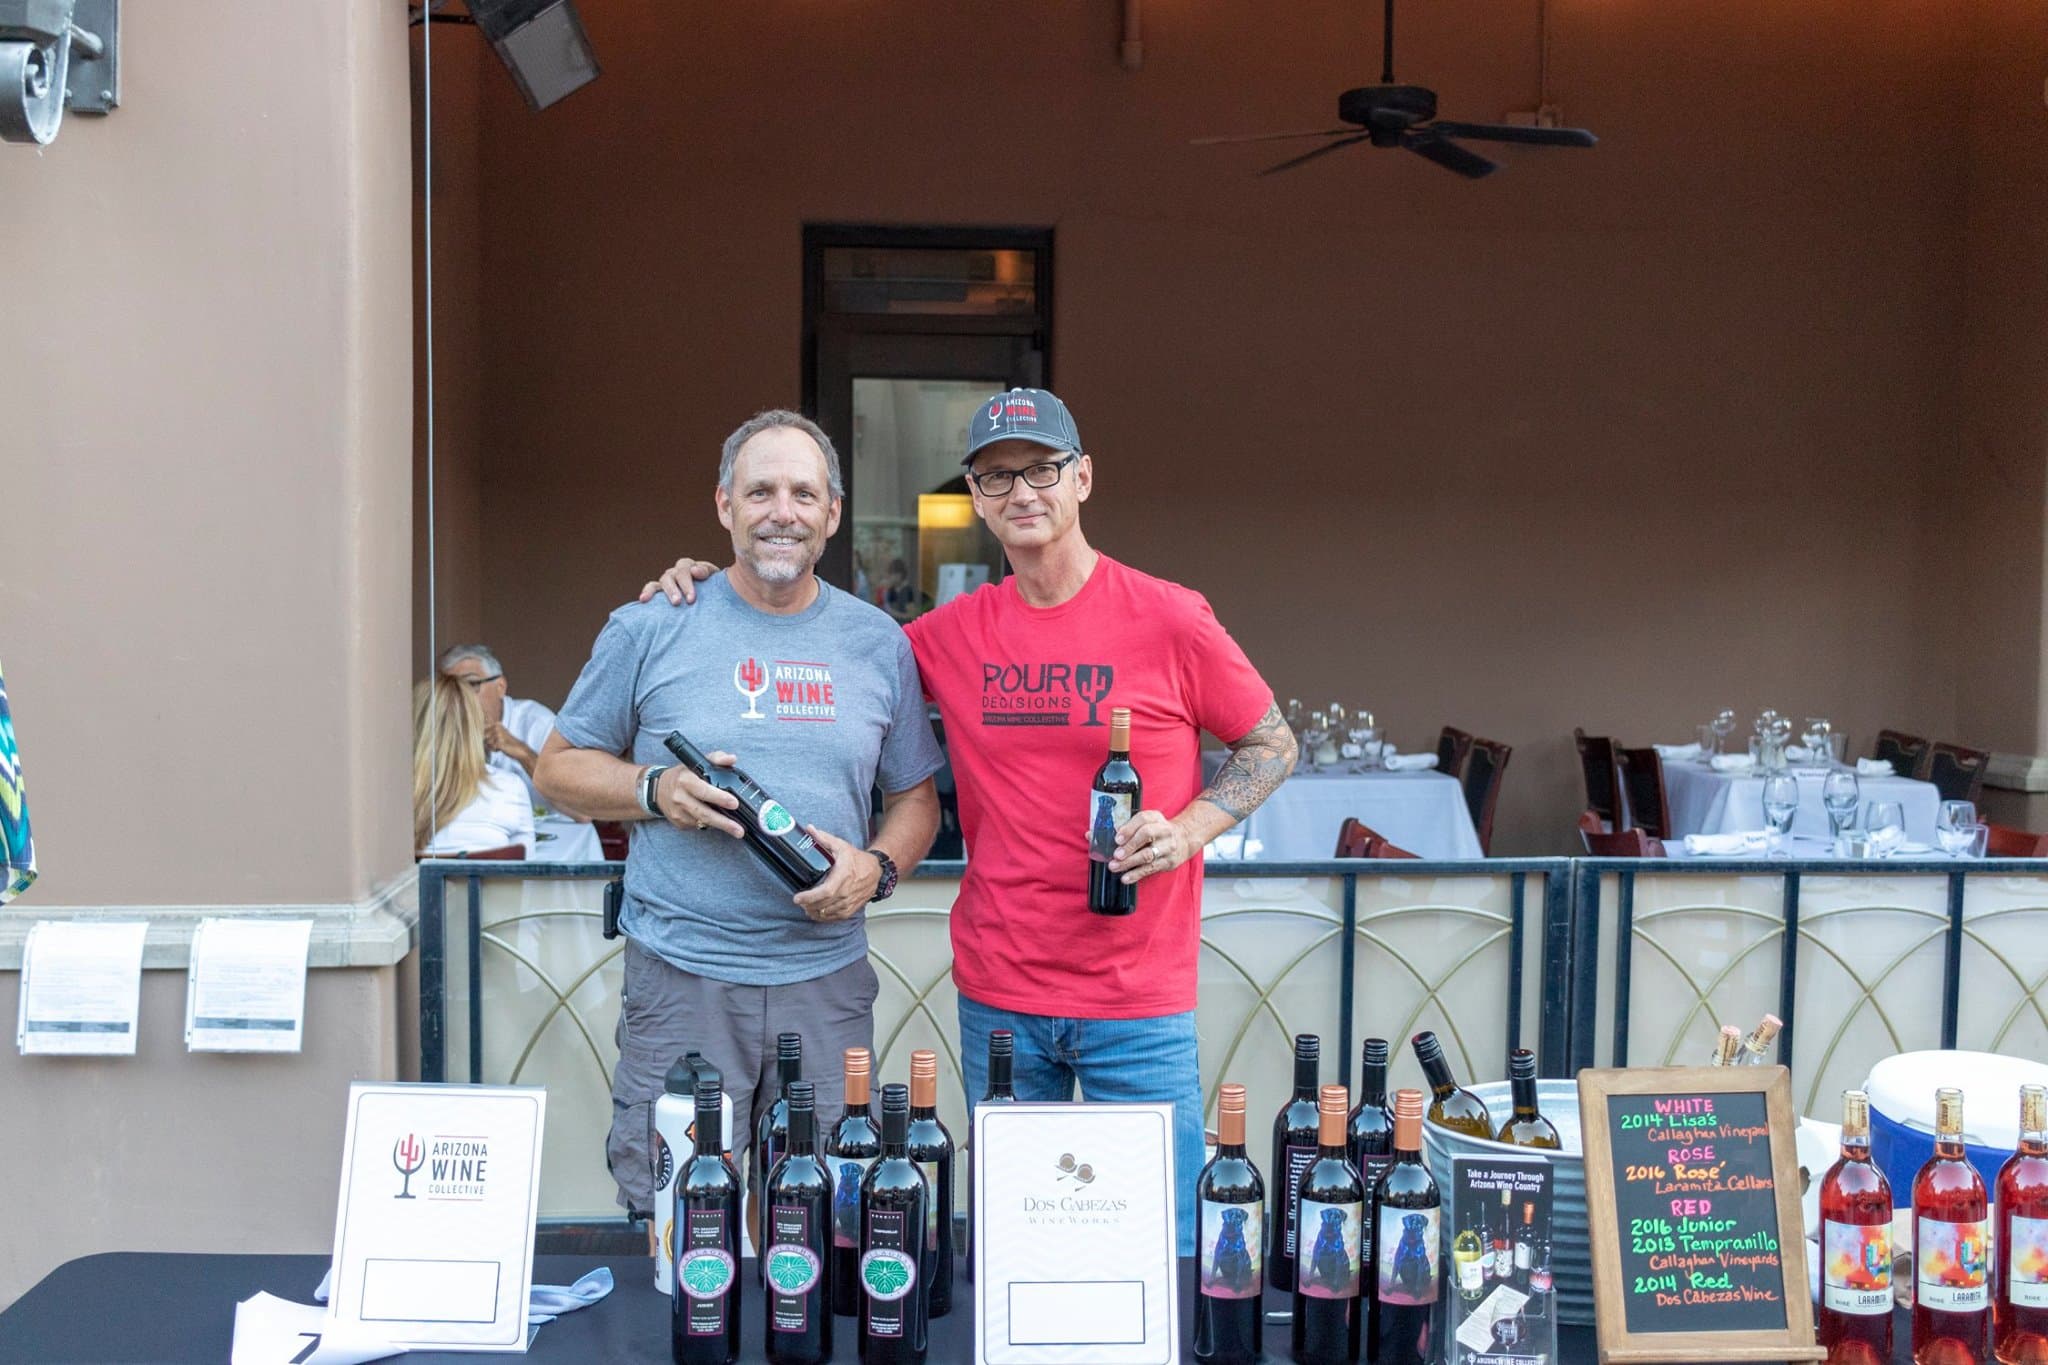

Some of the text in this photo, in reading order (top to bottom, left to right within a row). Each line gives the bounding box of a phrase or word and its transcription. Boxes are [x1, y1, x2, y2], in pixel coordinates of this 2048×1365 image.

[775, 666, 832, 682] ARIZONA
[983, 663, 1071, 693] POUR
[776, 680, 835, 705] WINE
[776, 705, 836, 716] COLLECTIVE
[982, 696, 1071, 709] DECISIONS
[1654, 1098, 1714, 1114] WHITE
[1621, 1113, 1718, 1129] 2014 Lisa's
[1647, 1127, 1717, 1145] Callaghan
[432, 1142, 488, 1156] ARIZONA
[1667, 1145, 1715, 1164] ROSE
[432, 1158, 488, 1182] WINE
[1467, 1168, 1544, 1183] Take a Journey Through
[1625, 1165, 1665, 1181] 2016
[428, 1184, 484, 1195] COLLECTIVE
[1470, 1179, 1540, 1193] Arizona Wine Country
[1655, 1179, 1727, 1195] Laramita
[1670, 1199, 1712, 1216] RED
[1631, 1216, 1737, 1236] 2016 Junior
[1632, 1231, 1778, 1257] 2013 Tempranillo
[1649, 1252, 1779, 1275] Callaghan Vineyards
[1634, 1271, 1734, 1293] 2014 Red
[1656, 1284, 1779, 1307] Dos Cabezas Wine
